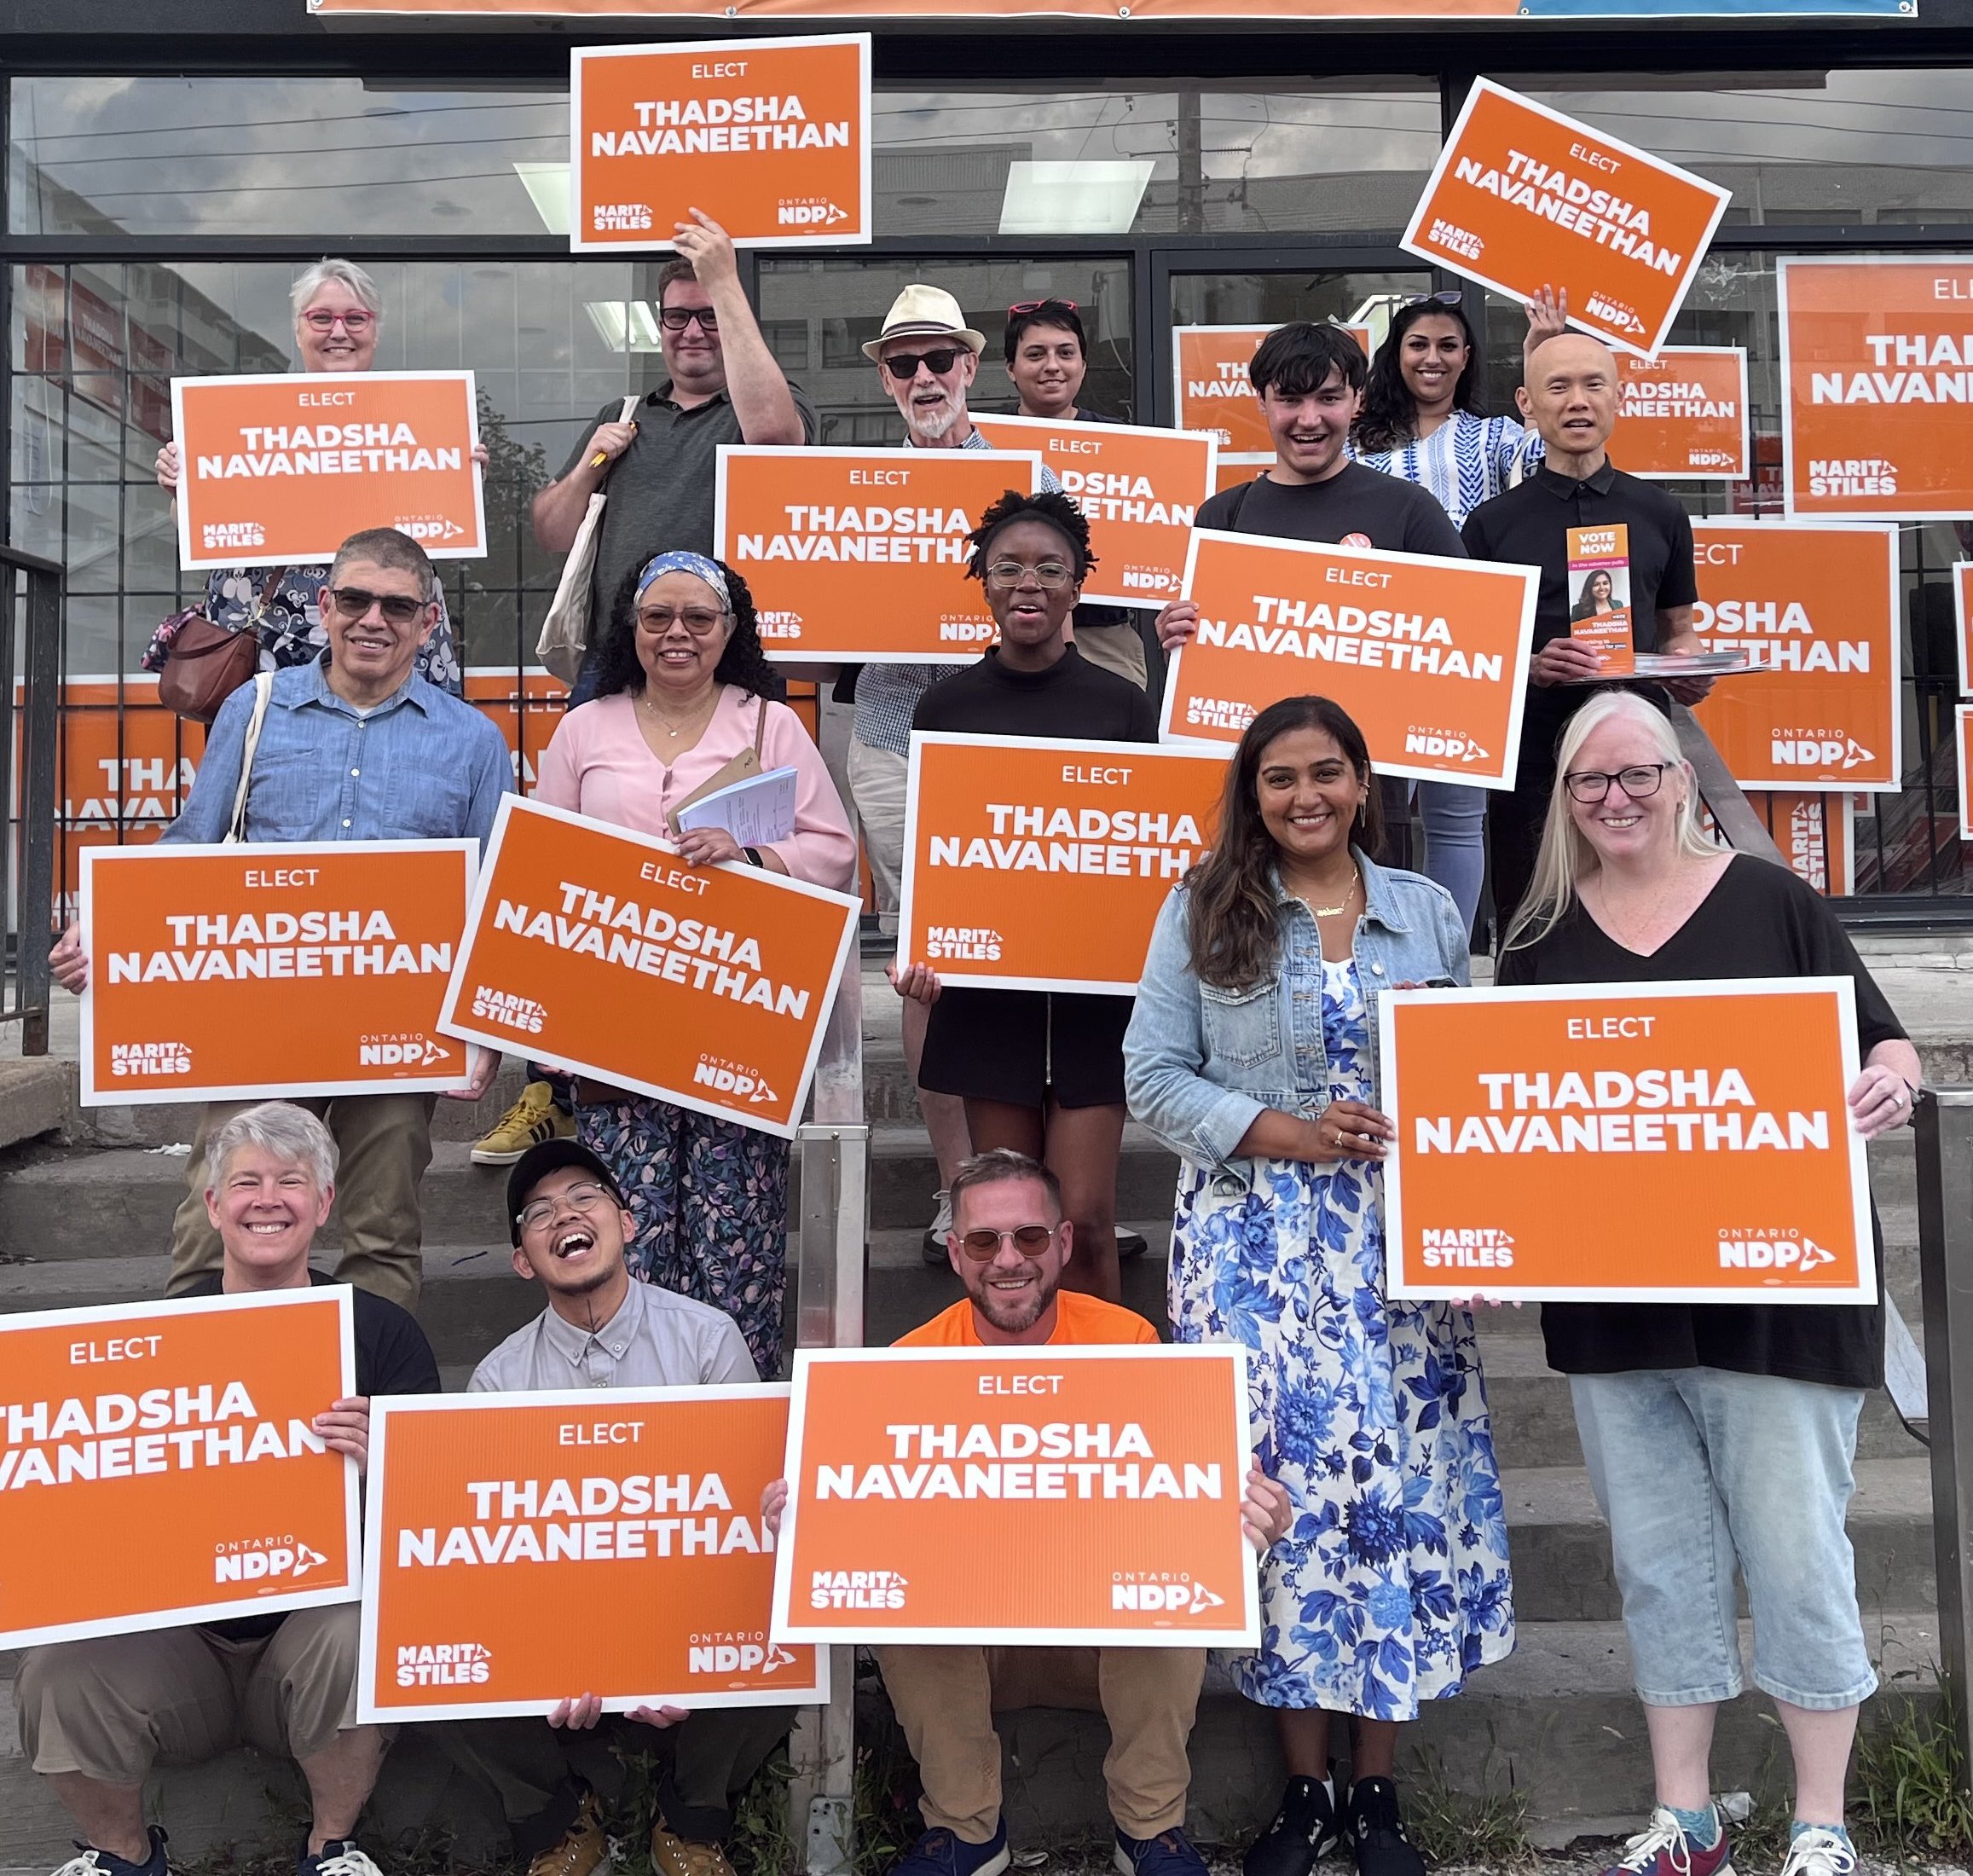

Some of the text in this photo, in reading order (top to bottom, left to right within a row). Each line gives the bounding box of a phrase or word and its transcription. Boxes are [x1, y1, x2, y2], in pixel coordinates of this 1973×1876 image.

[691, 61, 748, 79] ELECT
[634, 95, 806, 127] THADSHA
[592, 121, 849, 157] NAVANEETHAN
[1569, 142, 1621, 175] ELECT
[778, 197, 827, 206] ONTARIO
[1507, 149, 1650, 236] THADSHA
[594, 204, 642, 217] MARIT
[778, 206, 827, 224] NDP
[1454, 156, 1681, 277] NAVANEETHAN
[594, 216, 651, 230] STILES
[1432, 218, 1477, 246] MARIT
[1428, 229, 1481, 260] STILES
[1585, 297, 1630, 327] NDP
[1592, 291, 1635, 314] ONTARIO
[1629, 359, 1669, 370] ELECT
[298, 391, 356, 407] ELECT
[1623, 382, 1706, 400] ADSHA
[1618, 401, 1735, 418] NEETHAN
[240, 422, 417, 450] THADSHA
[1049, 438, 1103, 455] ELECT
[197, 447, 461, 480] NAVANEETHAN
[1689, 454, 1721, 466] NDP
[1809, 460, 1883, 477] MARIT
[849, 470, 911, 486] ELECT
[1060, 470, 1154, 499] DSHA
[1810, 477, 1897, 496] STILES
[394, 514, 443, 523] ONTARIO
[784, 505, 973, 535] THADSHA
[203, 523, 254, 537] MARIT
[204, 532, 265, 549] STILES
[1578, 531, 1616, 544] VOTE
[1580, 543, 1615, 554] NOW
[1693, 544, 1744, 565] ECT
[1124, 565, 1171, 574] ONTARIO
[1326, 567, 1392, 589] ELECT
[1123, 572, 1169, 590] NDP
[755, 611, 791, 625] ARIT
[940, 614, 993, 622] ONTARIO
[1253, 594, 1453, 646] THADSHA
[1692, 601, 1813, 634] DSHA
[940, 622, 992, 642] NDP
[1195, 618, 1503, 682] NAVANEETHAN
[1187, 696, 1247, 716] MARIT
[1186, 709, 1254, 732] STILES
[1408, 725, 1467, 739] ONTARIO
[1772, 728, 1844, 738] ONTARIO
[1404, 734, 1465, 758] NDP
[1772, 740, 1843, 766] NDP
[1062, 766, 1132, 785] ELECT
[986, 804, 1203, 846] THADSHA
[1808, 802, 1825, 890] STILES
[929, 836, 1194, 879] NAVANEETH
[246, 869, 320, 888] ELECT
[639, 862, 710, 896] ELECT
[165, 910, 396, 947] THADSHA
[558, 882, 762, 972] THADSHA
[928, 926, 992, 944] MARIT
[493, 899, 810, 1021] NAVANEETHAN
[927, 941, 1002, 961] STILES
[108, 942, 451, 984] NAVANEETHAN
[476, 985, 536, 1014] MARIT
[472, 999, 544, 1034] STILES
[1568, 1016, 1655, 1039] ELECT
[361, 1033, 423, 1043] ONTARIO
[112, 1043, 179, 1059] MARIT
[361, 1043, 423, 1066] NDP
[112, 1057, 191, 1076] STILES
[700, 1053, 759, 1076] ONTARIO
[693, 1062, 755, 1097] NDP
[1478, 1068, 1756, 1109] THADSHA
[1415, 1111, 1829, 1154] NAVANEETHAN
[1422, 1229, 1498, 1248] MARIT
[1719, 1228, 1798, 1238] ONTARIO
[1422, 1247, 1514, 1268] STILES
[1719, 1242, 1800, 1268] NDP
[70, 1335, 162, 1365] ELECT
[978, 1375, 1063, 1395] ELECT
[558, 1421, 645, 1445] ELECT
[886, 1423, 1154, 1459] THADSHA
[815, 1463, 1222, 1500] NAVANEETHAN
[467, 1473, 732, 1520] THADSHA
[216, 1535, 293, 1554] ONTARIO
[216, 1548, 294, 1584] NDP
[812, 1571, 892, 1589] MARIT
[1112, 1572, 1190, 1583] ONTARIO
[810, 1588, 905, 1609] STILES
[1112, 1584, 1189, 1611] NDP
[690, 1631, 764, 1643] ONTARIO
[397, 1645, 474, 1665] MARIT
[689, 1645, 764, 1674] NDP
[396, 1662, 489, 1688] STILES
